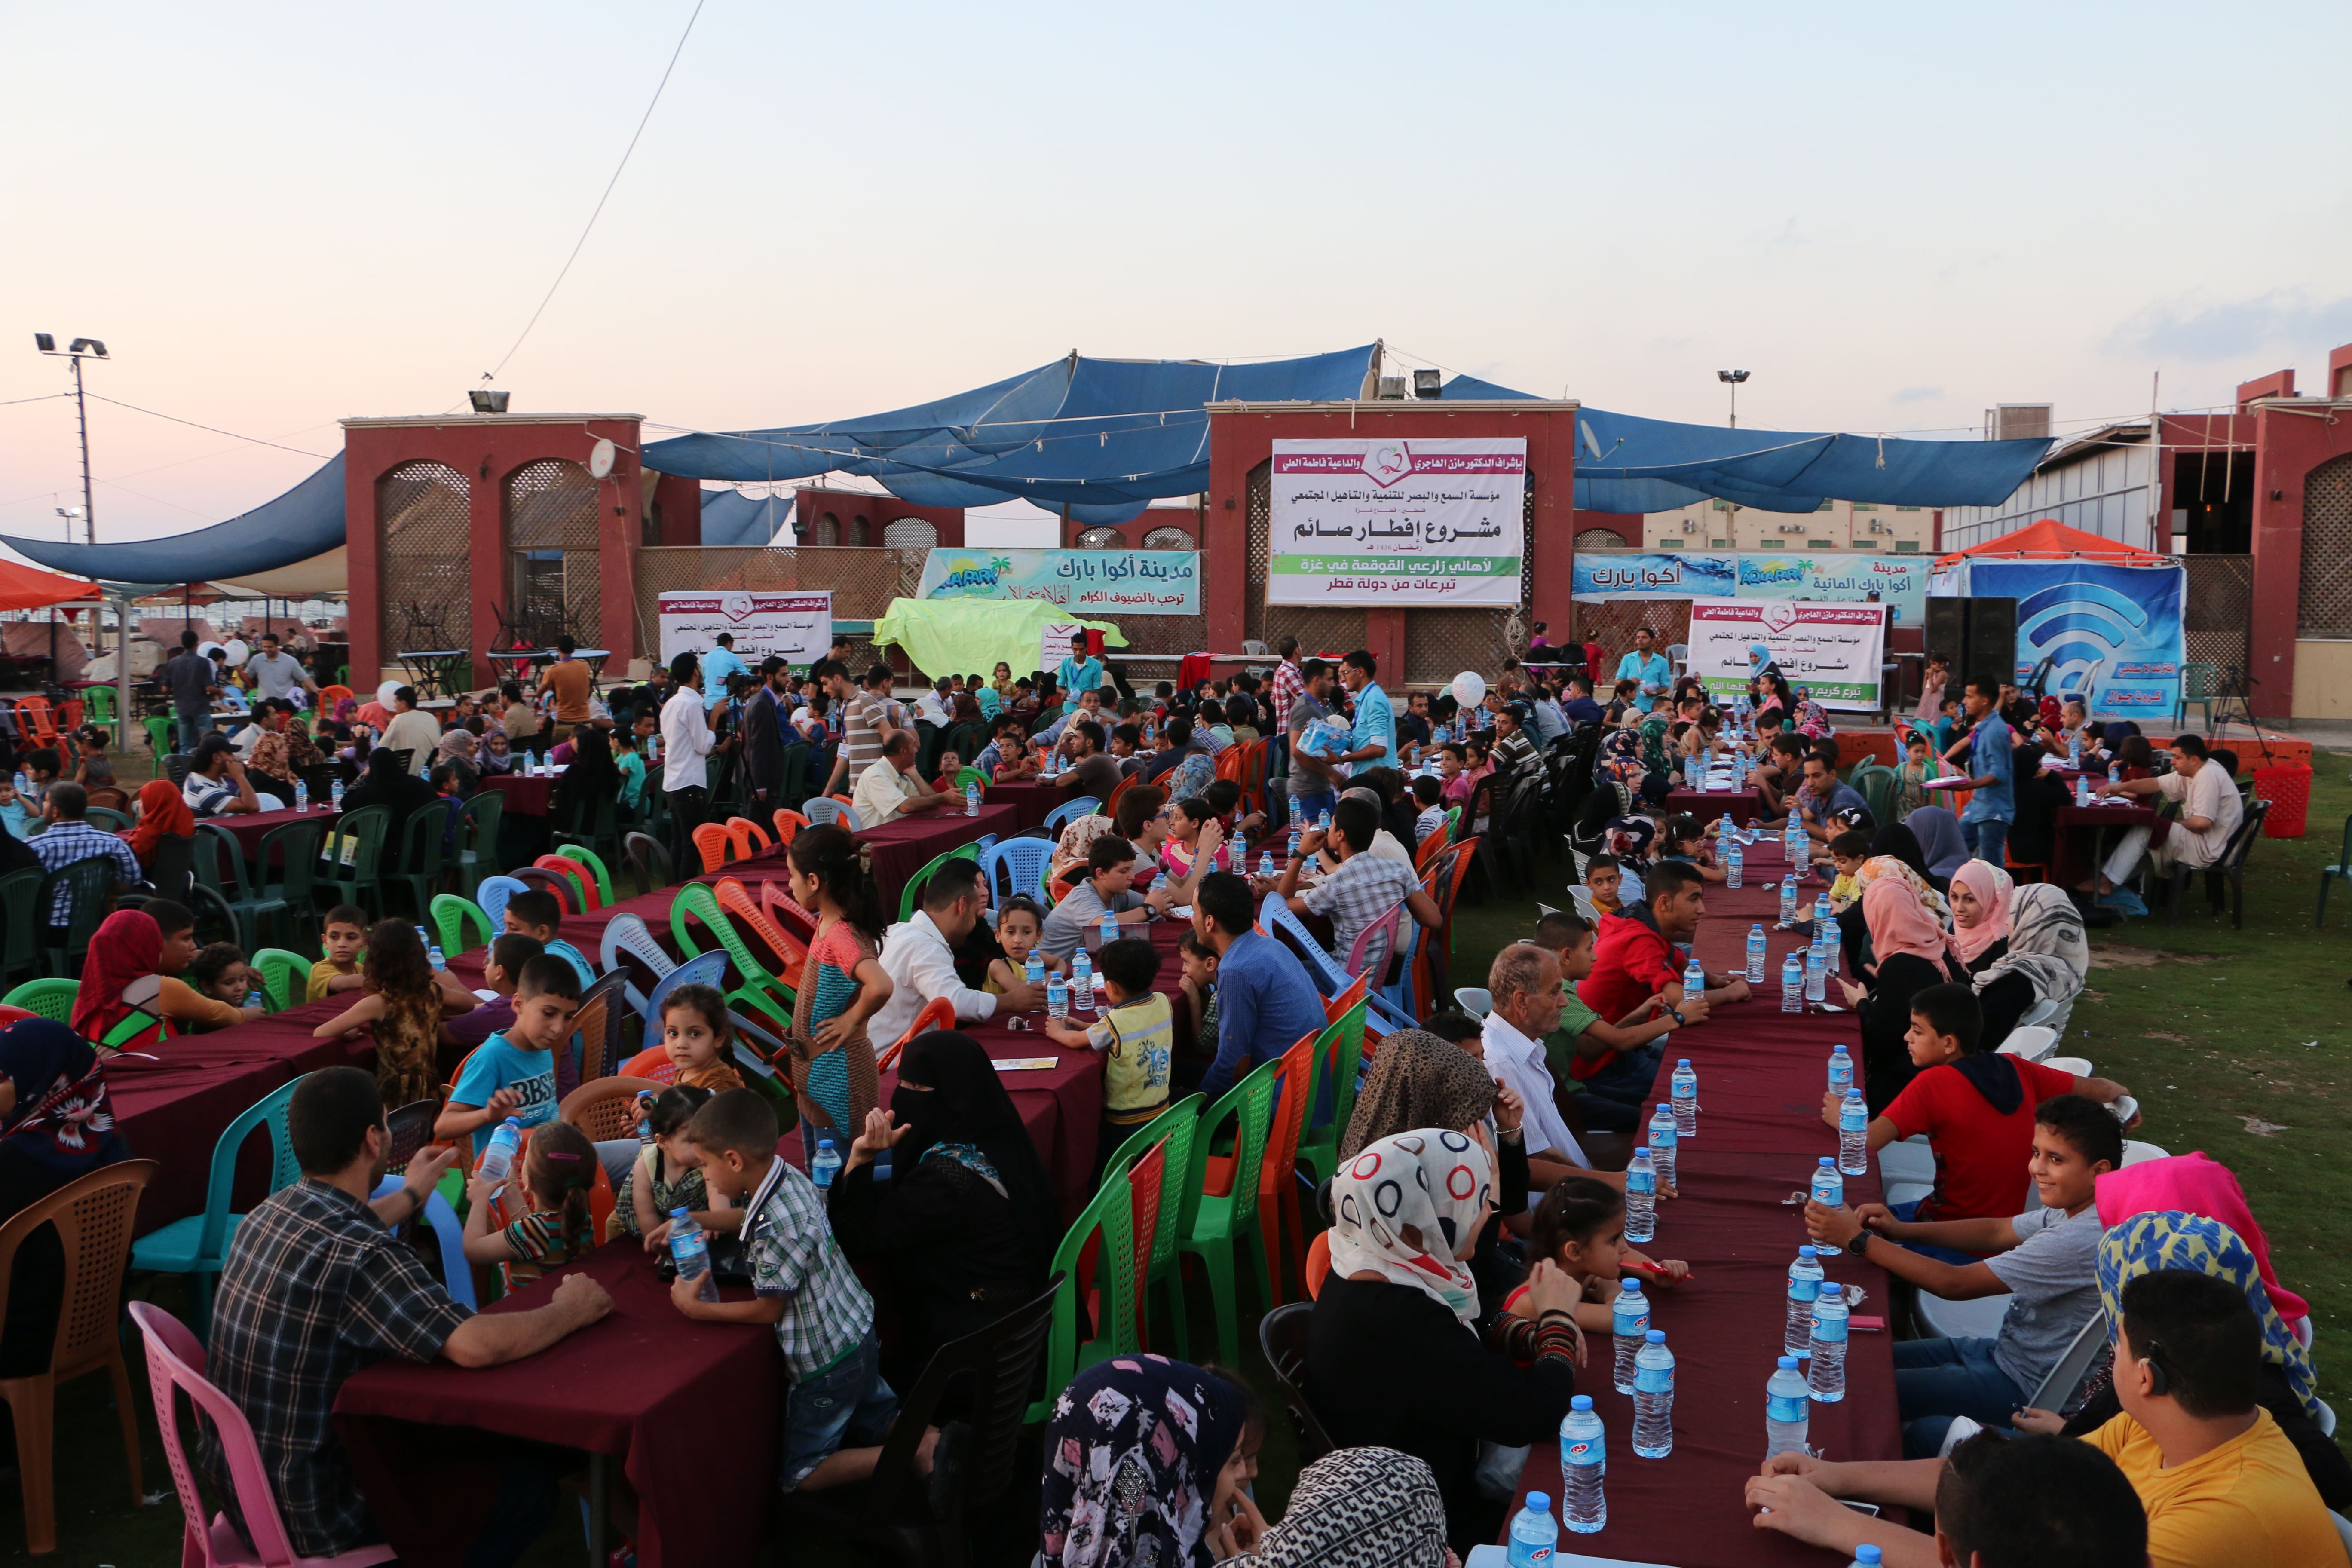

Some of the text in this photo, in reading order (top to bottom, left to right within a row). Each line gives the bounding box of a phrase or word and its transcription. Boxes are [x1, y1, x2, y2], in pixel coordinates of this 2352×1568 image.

[1283, 457, 1360, 471] والداعية فاطمة العلي
[1415, 457, 1523, 471] بإشراف الدكتور مازن الهاجري
[1292, 490, 1500, 504] مؤسسة السمع والبصر للتنمية والتأهيل المجتمعي
[1294, 517, 1501, 544] مشروع إفطار صائم
[1393, 543, 1422, 552] رمضان
[1056, 554, 1193, 582] مدينة أكوا بارك
[1301, 558, 1491, 574] لأهالي زارعي القوقعة في غزة
[1874, 562, 1907, 575] مدينة
[1592, 561, 1682, 589] أكوا بارك
[1740, 570, 1776, 585] AQUA
[1774, 568, 1803, 581] PARK
[1326, 578, 1455, 592] تبرعات من دولة قطر
[1813, 577, 1855, 591] المائية
[1858, 578, 1884, 593] بارك
[1889, 576, 1911, 593] أكوا
[1079, 590, 1185, 606] ترحب بالضيوف الكرام
[1768, 633, 1791, 643] للتنمية
[1792, 635, 1816, 643] والبصر
[1817, 635, 1836, 645] السمع
[1838, 635, 1860, 645] مؤسسة
[732, 644, 758, 655] إفط
[1777, 658, 1798, 670] إفط
[1801, 658, 1849, 672] مشروع
[2118, 663, 2142, 677] سلكي
[2143, 663, 2151, 673] لا
[1709, 680, 1724, 689] الله
[1815, 686, 1840, 697] كريم
[1842, 687, 1861, 698] تبرع
[2107, 690, 2162, 704] كروت جوال
